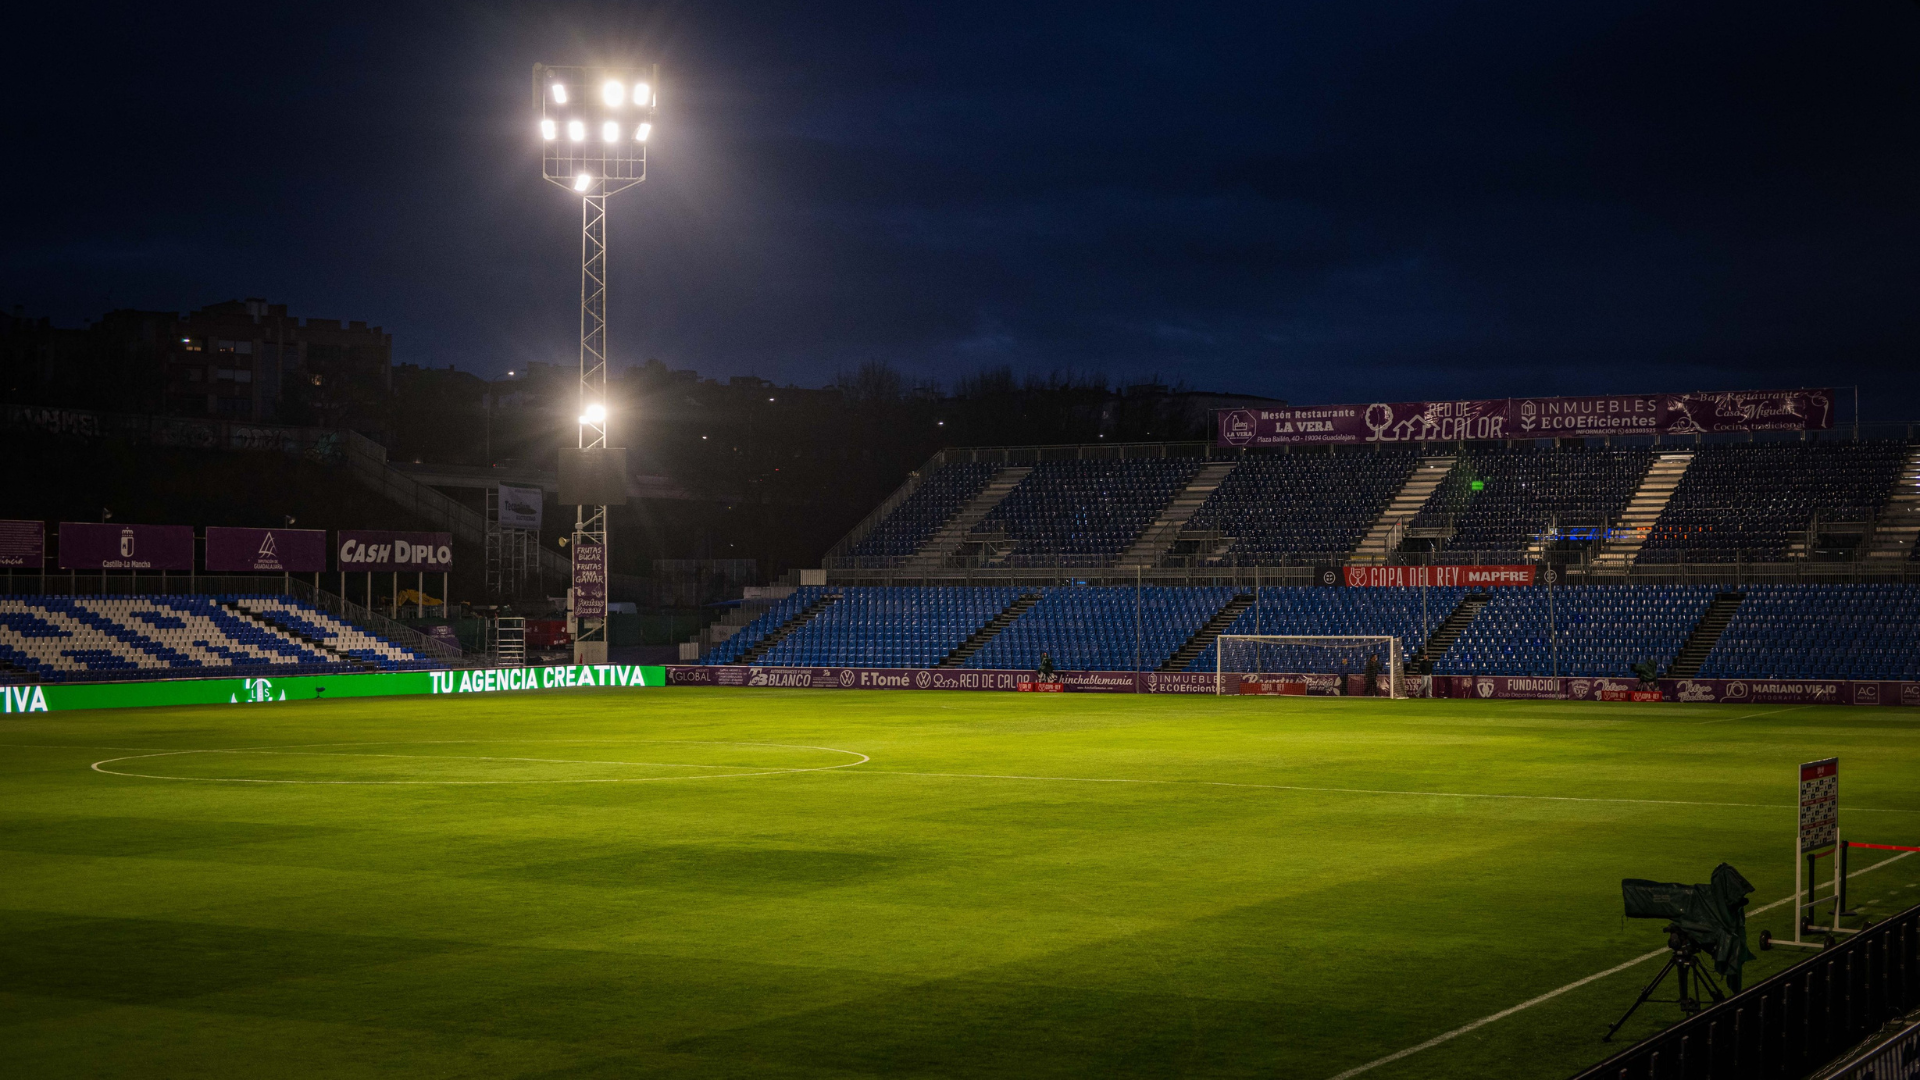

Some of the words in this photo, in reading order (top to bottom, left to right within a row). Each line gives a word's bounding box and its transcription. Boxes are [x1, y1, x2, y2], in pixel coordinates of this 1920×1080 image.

[1700, 393, 1721, 402] Bar
[1727, 391, 1799, 401] Restaurante
[1429, 402, 1452, 417] RED
[1456, 401, 1471, 417] DE
[1541, 400, 1657, 415] INMUEBLES
[1715, 407, 1740, 417] Casa
[1261, 411, 1291, 420] Mesón
[1295, 409, 1355, 419] Restaurante
[1275, 422, 1294, 432] LA
[1296, 421, 1334, 432] VERA
[1541, 415, 1657, 429] ECOEficientes
[1713, 423, 1748, 431] Cocina
[1751, 421, 1806, 430] tradicional
[1442, 416, 1503, 440] CALOR
[1322, 434, 1356, 442] Guadalajara
[340, 539, 392, 563] CASH
[394, 540, 451, 564] DIPLO
[103, 560, 130, 568] Castilla-La
[131, 560, 151, 568] Mancha
[575, 575, 604, 584] GANAR
[1371, 567, 1403, 587] COPA
[1409, 567, 1431, 587] DEL
[1437, 567, 1459, 587] REY
[1468, 571, 1529, 582] MAPFRE
[429, 671, 454, 694] TU
[458, 668, 538, 693] AGENCIA
[543, 665, 645, 688] CREATIVA
[675, 672, 711, 682] GLOBAL
[768, 674, 811, 687] BLANCO
[860, 671, 910, 686] F.Tomé
[960, 673, 979, 688] RED
[982, 674, 995, 688] DE
[997, 674, 1030, 689] CALOR
[1160, 675, 1226, 684] INMUEBLES
[1507, 677, 1560, 691] FUNDACIÓN
[1752, 684, 1803, 693] MARIANO
[1804, 684, 1837, 694] VIEJO
[1857, 686, 1876, 696] AC
[1904, 686, 1920, 695] AC
